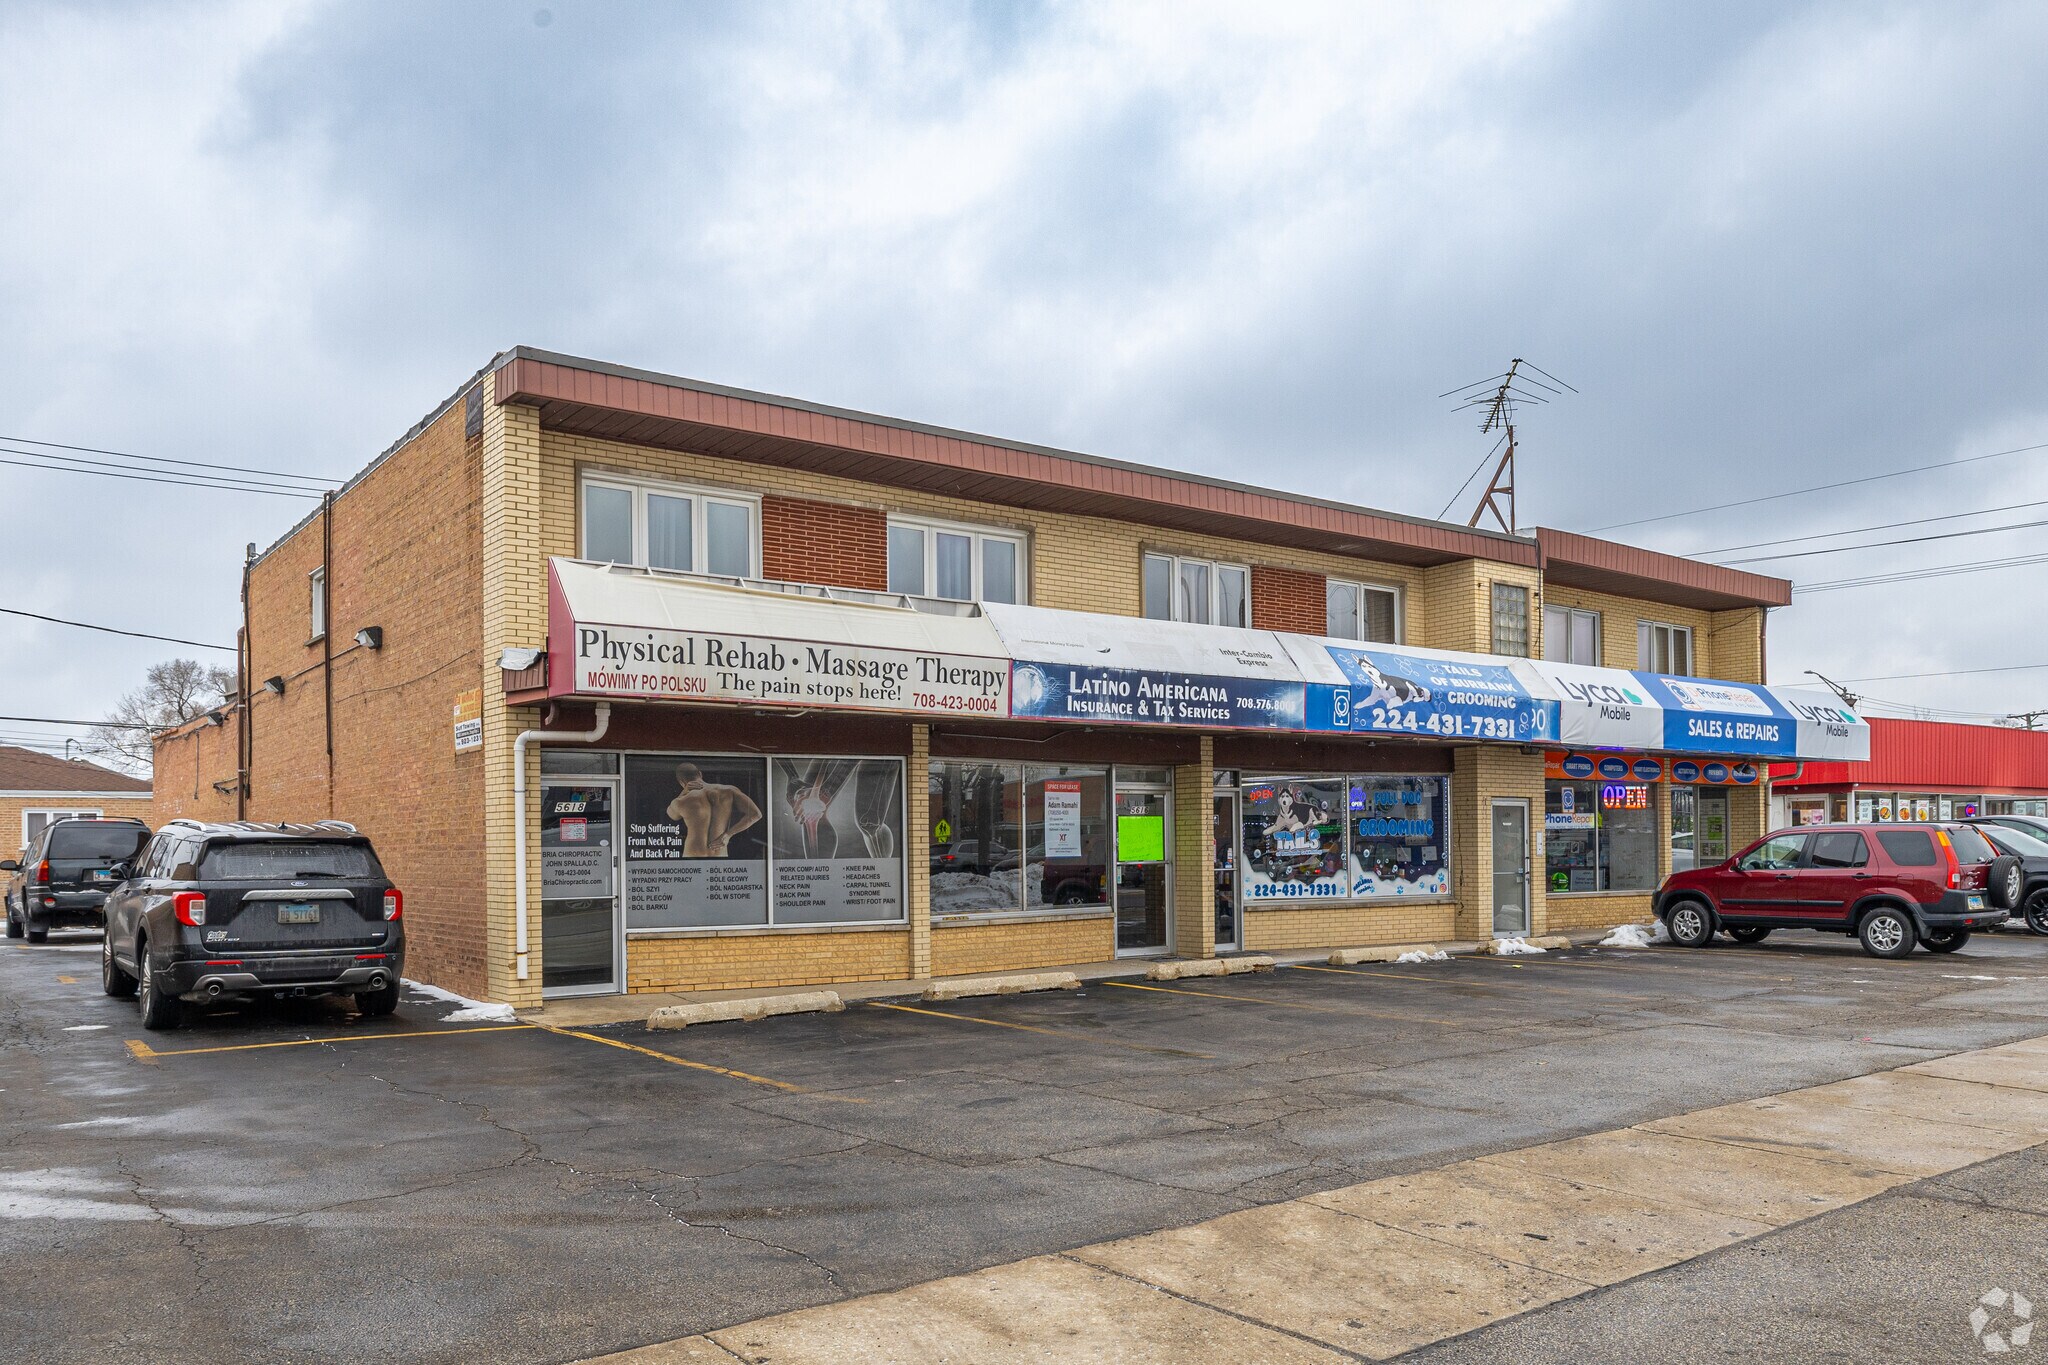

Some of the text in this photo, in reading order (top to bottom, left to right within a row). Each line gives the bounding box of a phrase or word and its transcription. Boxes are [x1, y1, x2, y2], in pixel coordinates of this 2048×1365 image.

[1218, 647, 1273, 660] Inter-Cambio
[579, 628, 1007, 696] Physical Rehab Massage Therapy
[1236, 657, 1268, 668] Express
[1441, 664, 1483, 677] TAILS
[587, 665, 707, 693] MÓWIMY PO POLSKU
[1432, 677, 1517, 692] OF BURBANK
[716, 671, 902, 703] The pain stops here!
[1554, 676, 1629, 707] Lyca
[912, 692, 998, 712] 708-423-0004
[1447, 691, 1517, 709] GROOMING
[1137, 700, 1149, 716] &
[1600, 705, 1631, 721] Mobile
[1788, 700, 1847, 726] Lyca
[1372, 708, 1516, 739] 224-431-7331
[1688, 718, 1779, 741] SALES & REPAIRS
[1826, 724, 1849, 738] Mobile
[1250, 789, 1273, 801] OPEN
[1374, 790, 1422, 805] FULL DOG
[1603, 785, 1647, 810] OPEN
[556, 802, 585, 812] 5618
[1130, 806, 1150, 814] 5616
[630, 823, 680, 835] Stop Suffering
[1359, 818, 1434, 837] GROOMING
[628, 836, 682, 846] From Neck Pain
[1273, 829, 1321, 851] TAILS
[558, 850, 602, 858] CHIROPRACTIC
[630, 848, 680, 858] And Back Pain
[631, 867, 657, 875] WYPADKI
[1254, 883, 1337, 897] 224-431-7331
